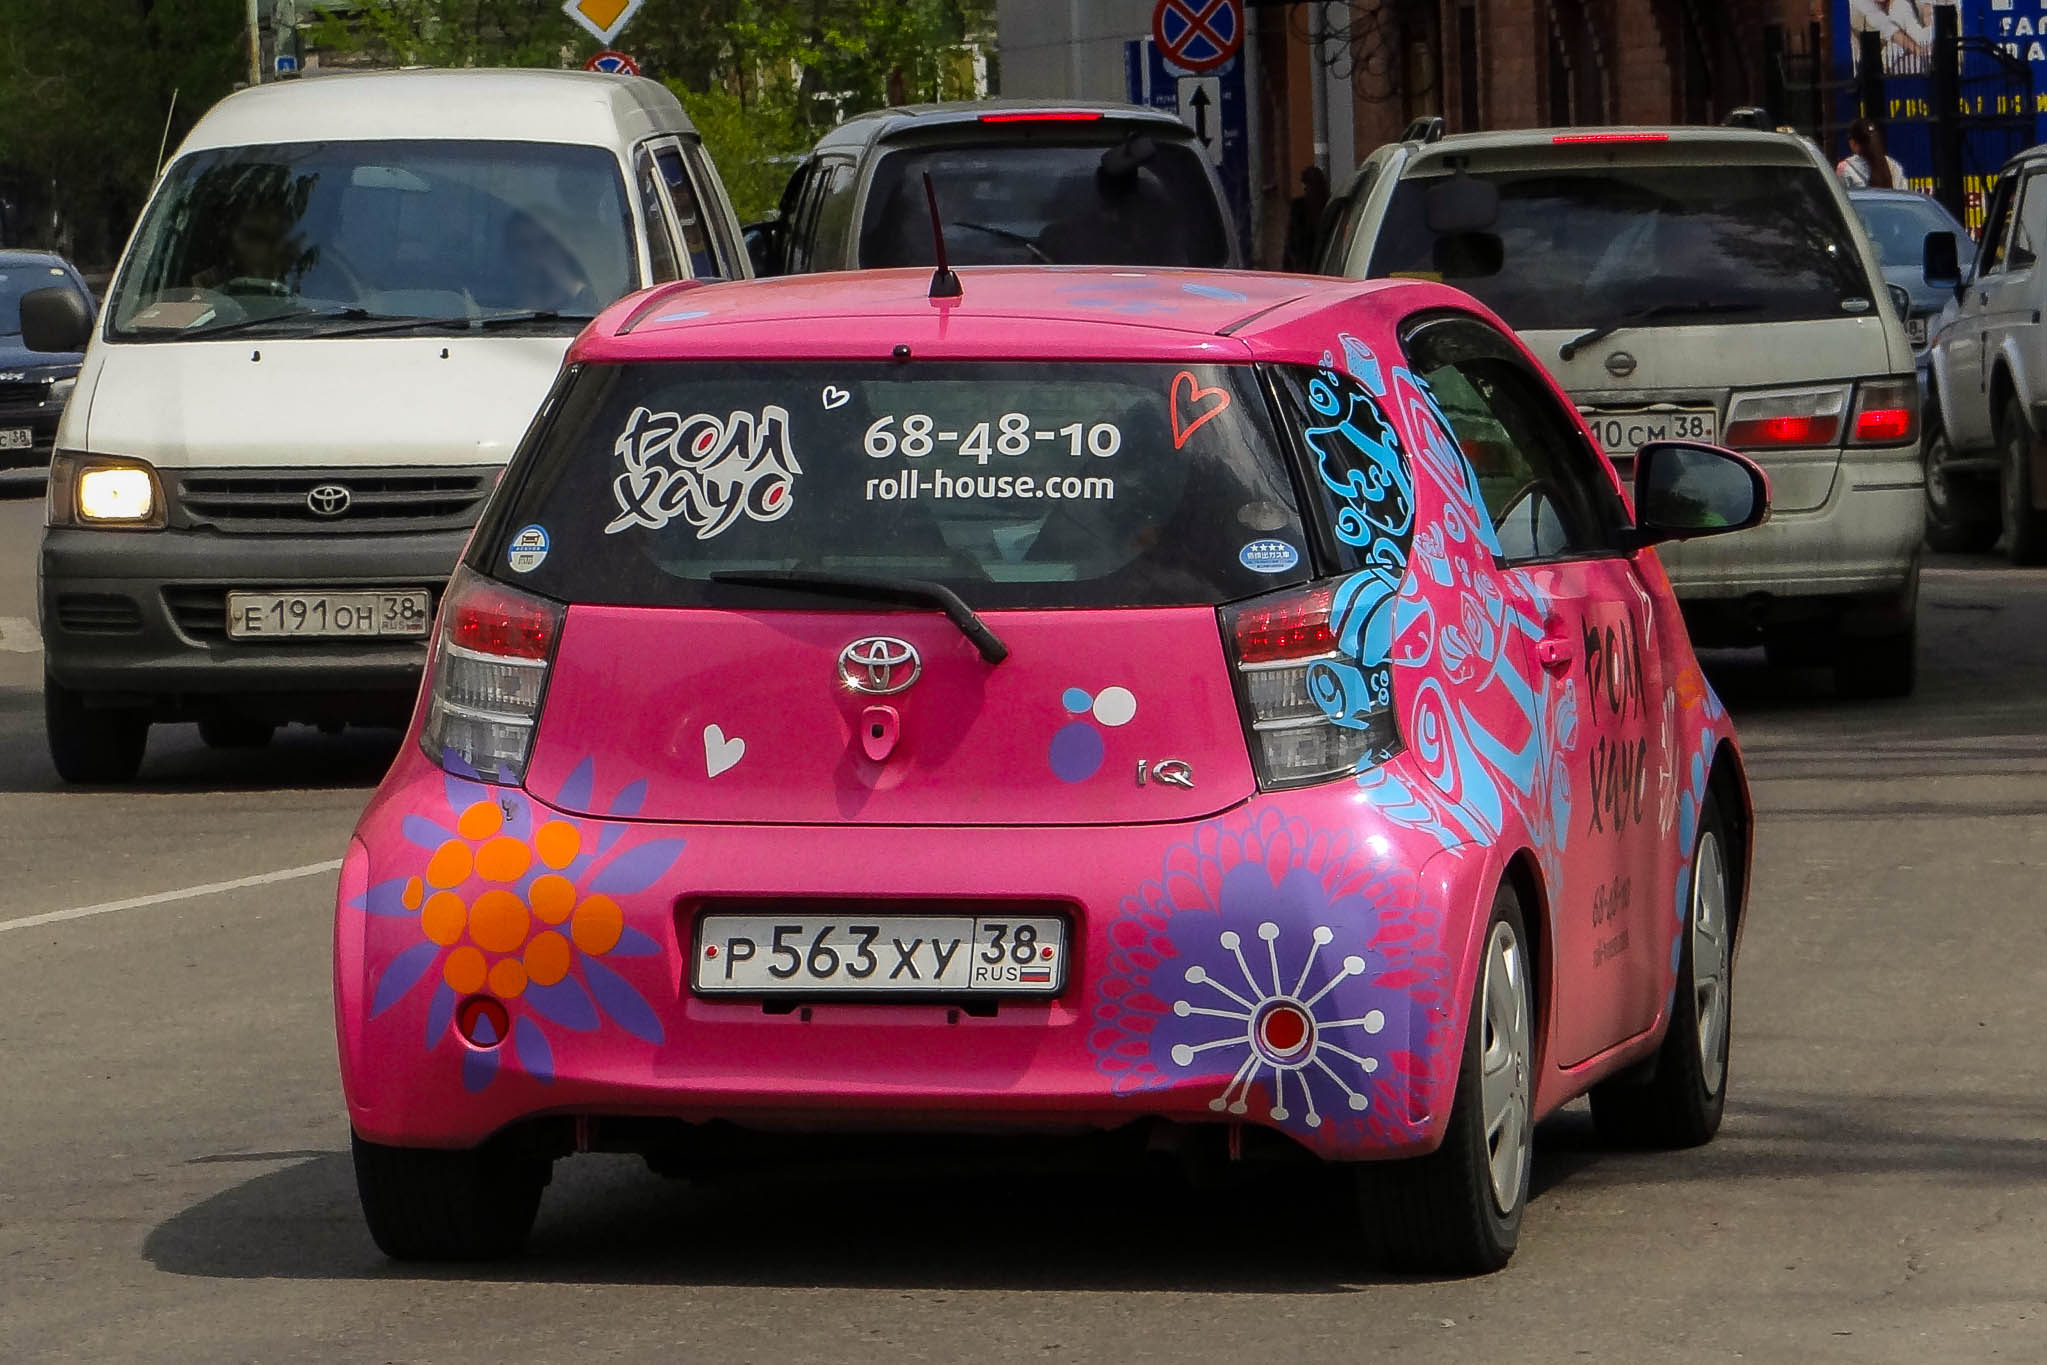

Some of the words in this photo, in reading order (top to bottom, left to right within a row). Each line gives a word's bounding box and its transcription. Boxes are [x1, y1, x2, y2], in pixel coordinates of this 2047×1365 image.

[864, 412, 1122, 465] 68-48-10
[1675, 416, 1703, 438] 38
[866, 469, 1114, 500] roll-house.com
[384, 597, 414, 621] 38
[981, 924, 1038, 965] 38
[974, 966, 1018, 983] RUS
